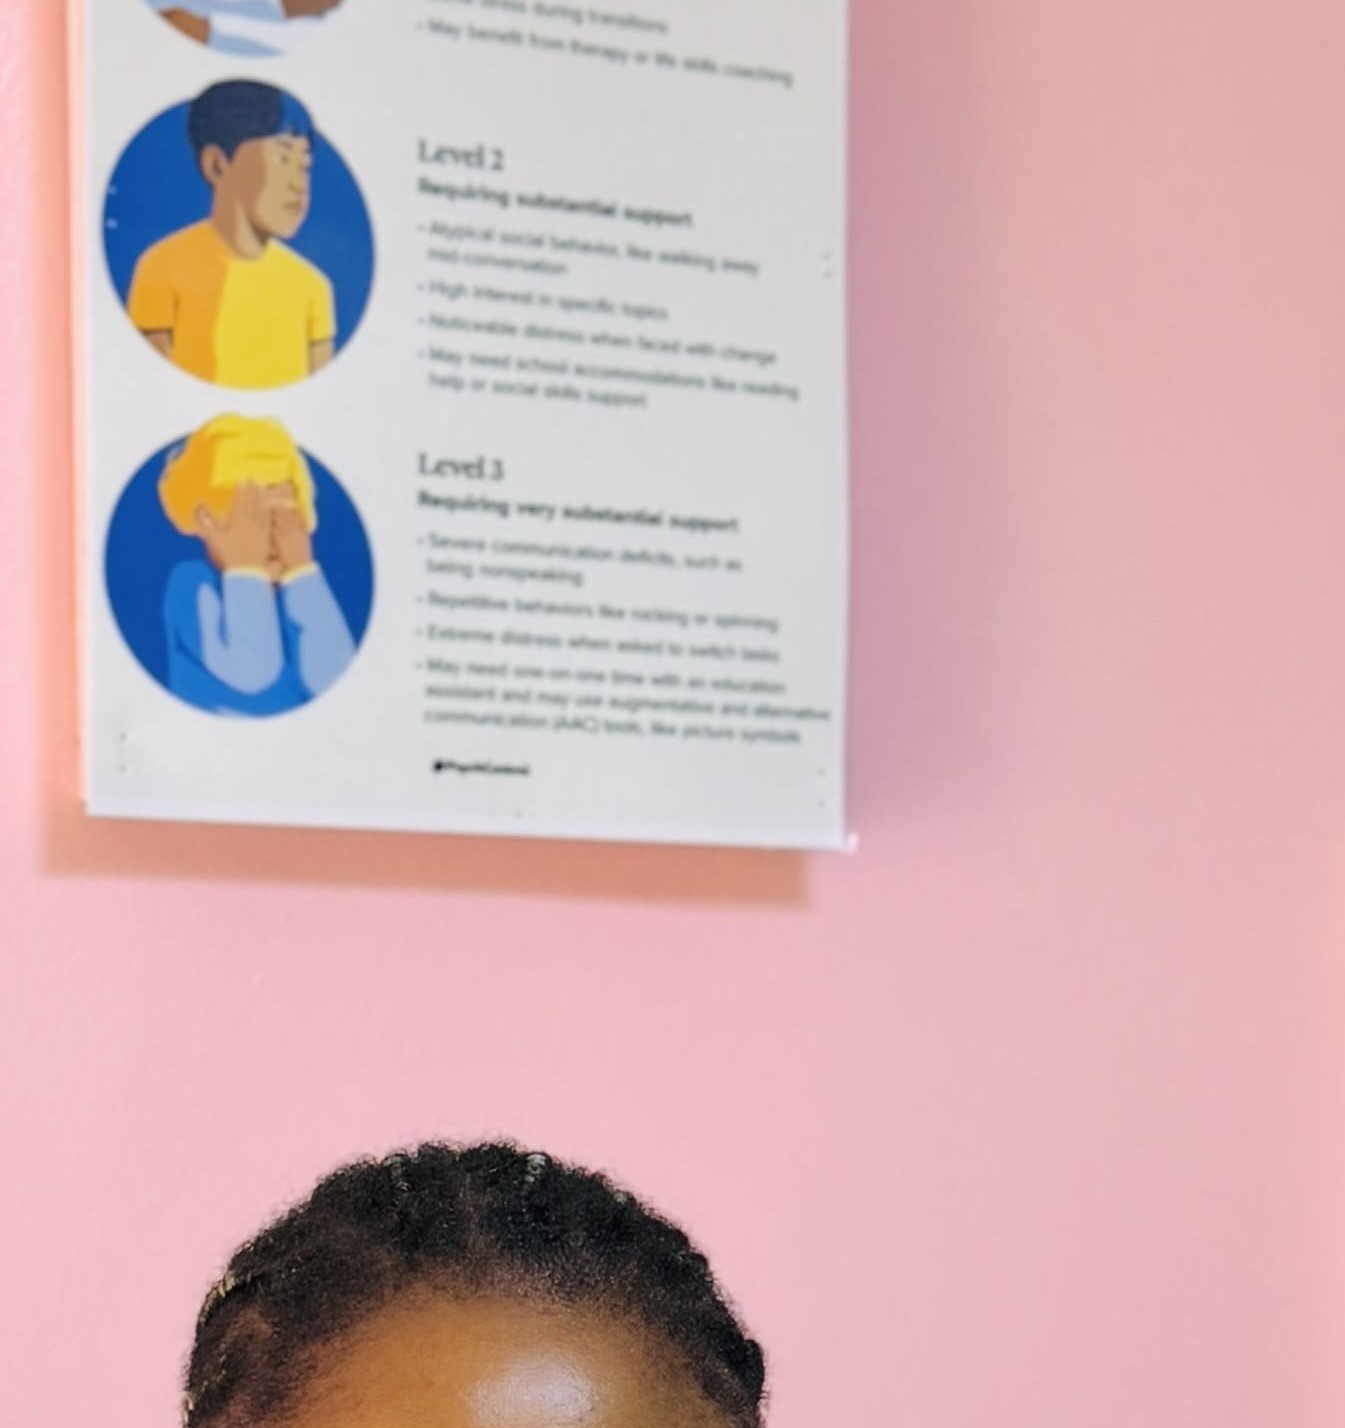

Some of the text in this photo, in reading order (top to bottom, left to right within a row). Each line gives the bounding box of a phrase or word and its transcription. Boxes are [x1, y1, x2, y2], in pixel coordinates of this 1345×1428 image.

[428, 247, 568, 275] mid-conversation
[429, 220, 760, 277] Atypical social behavior, like walking away
[428, 281, 669, 323] High interest in specific topics
[428, 314, 777, 366] Noticeable distress when faced with change
[428, 346, 800, 402] May need school accommodations like reading
[428, 372, 648, 408] help or social skills support
[418, 452, 504, 482] Level 3
[418, 490, 739, 534] Requiring very substantial support
[428, 532, 742, 572] Severe communication deficits, such as
[426, 559, 584, 588] being nonspeaking
[428, 592, 781, 634] Repetitive behaviors like rocking or spinning
[427, 624, 781, 664] Extreme distress when asked to switch tasks
[426, 658, 786, 695] May need one-on-one time with an education
[425, 683, 832, 722] assistant and may use augmentative and alternative
[424, 709, 801, 745] communication (AAC) tools, like picture symbols
